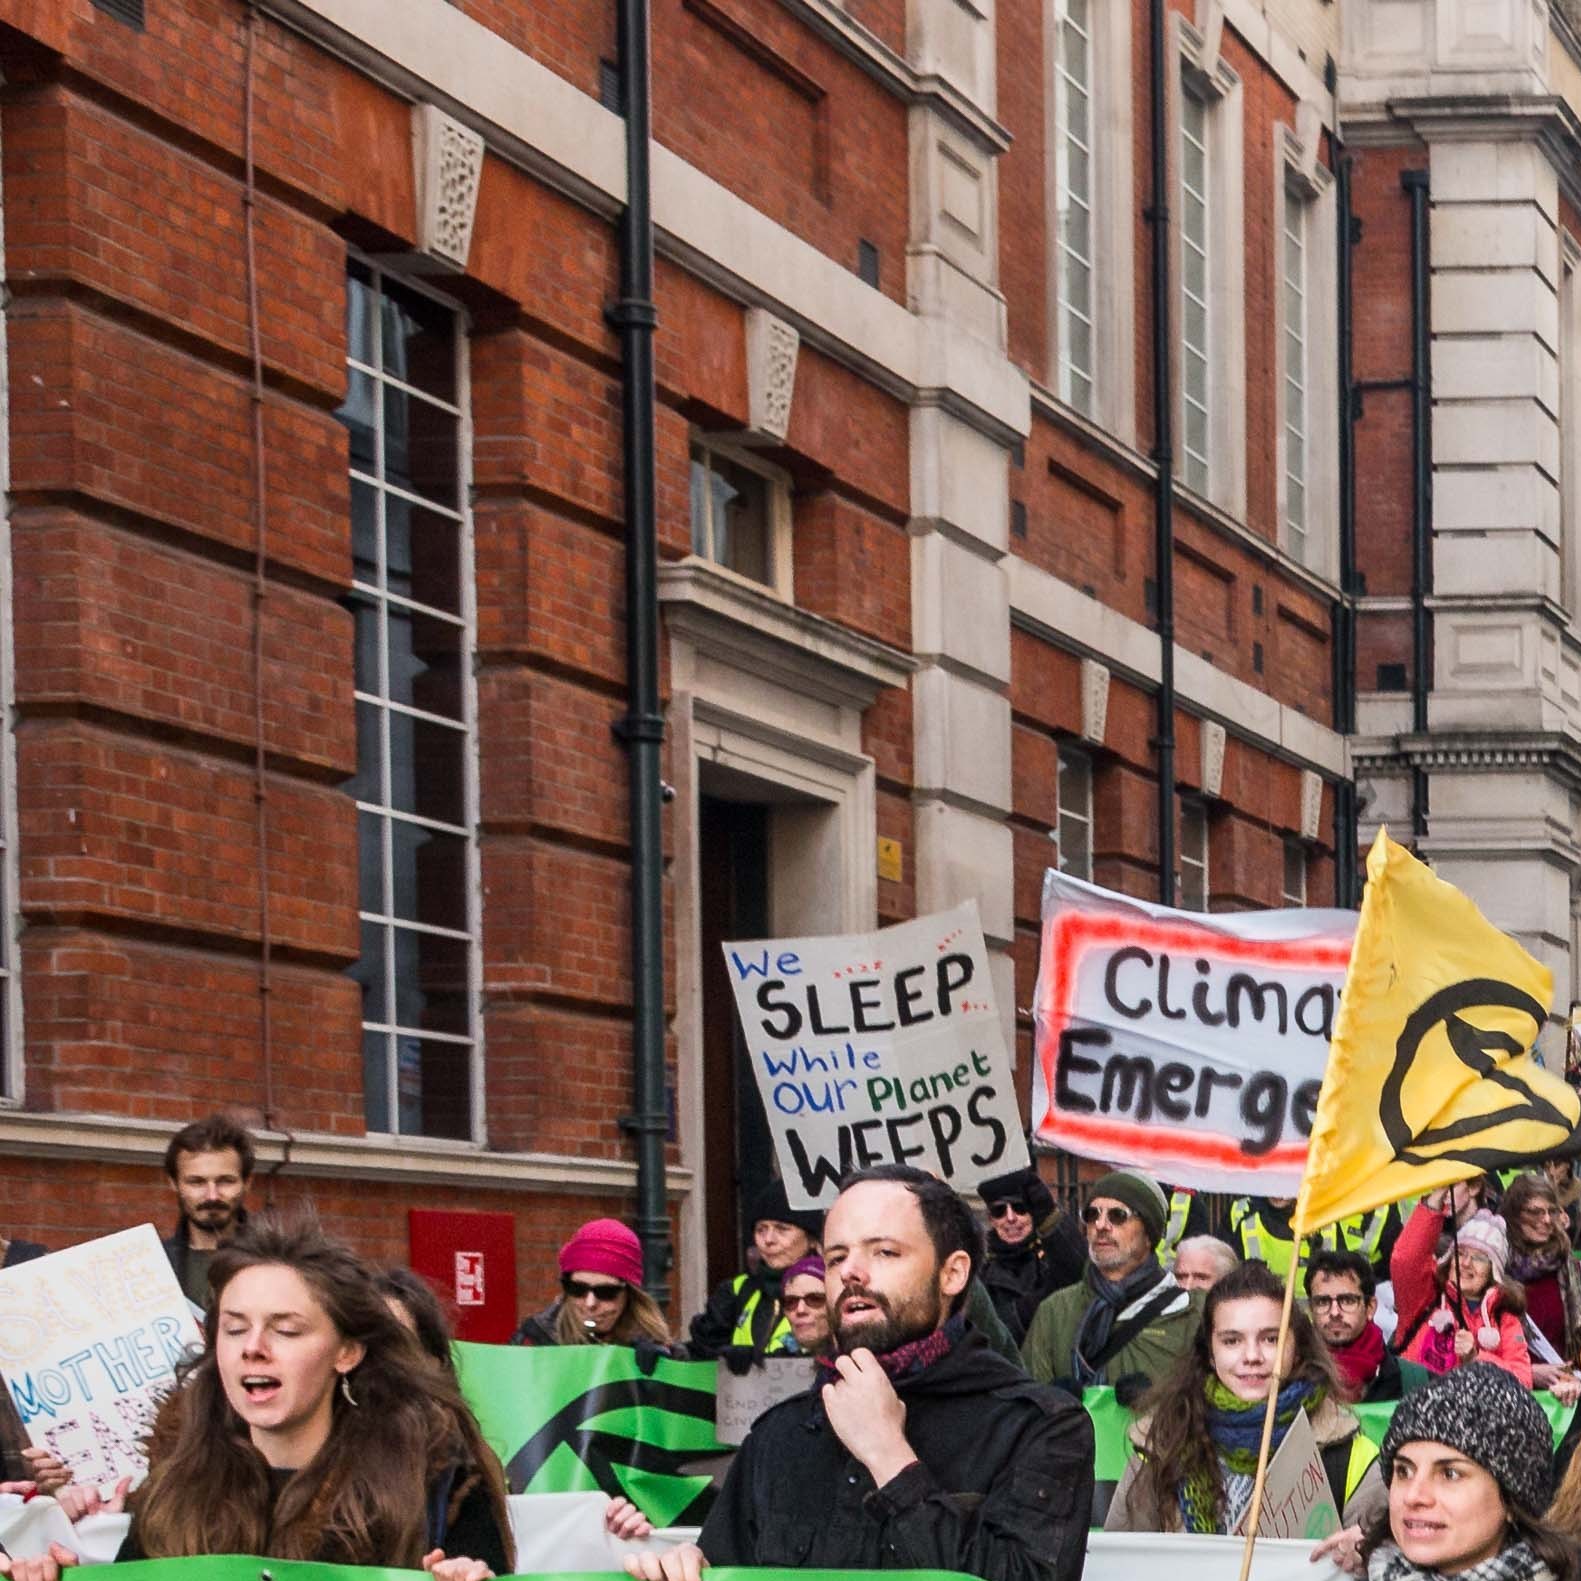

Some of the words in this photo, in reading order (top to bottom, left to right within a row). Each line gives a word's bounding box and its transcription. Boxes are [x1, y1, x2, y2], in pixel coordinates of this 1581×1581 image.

[731, 949, 802, 980] We
[756, 953, 975, 1040] SLEEP
[1104, 945, 1345, 1041] Clima
[761, 1042, 882, 1078] While
[866, 1050, 992, 1113] Planet
[785, 1085, 1007, 1198] WEEPS
[10, 1316, 185, 1424] MOTHER
